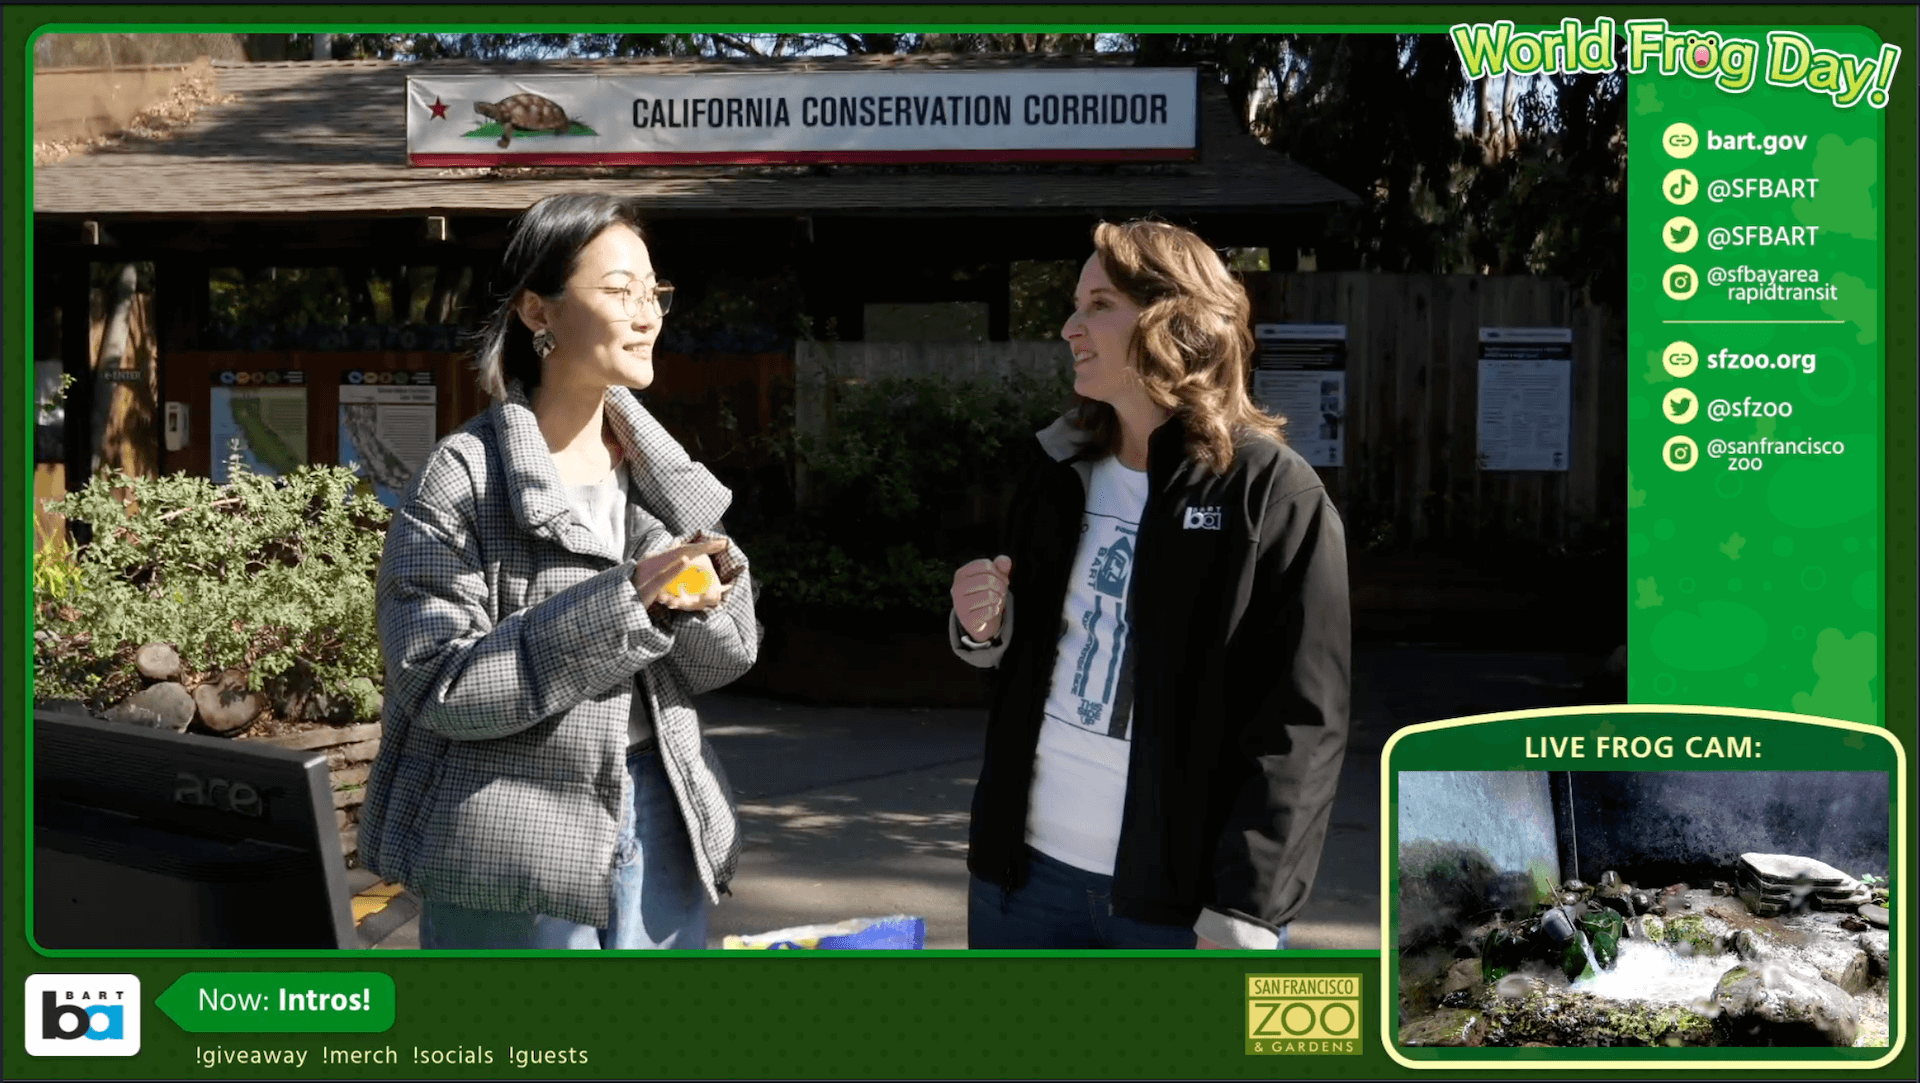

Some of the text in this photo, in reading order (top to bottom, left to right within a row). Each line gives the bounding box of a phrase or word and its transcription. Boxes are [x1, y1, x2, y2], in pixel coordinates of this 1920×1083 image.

[632, 94, 1168, 129] CALIFORNIA CONSERVATION CORRIDOR
[1088, 547, 1108, 590] BART
